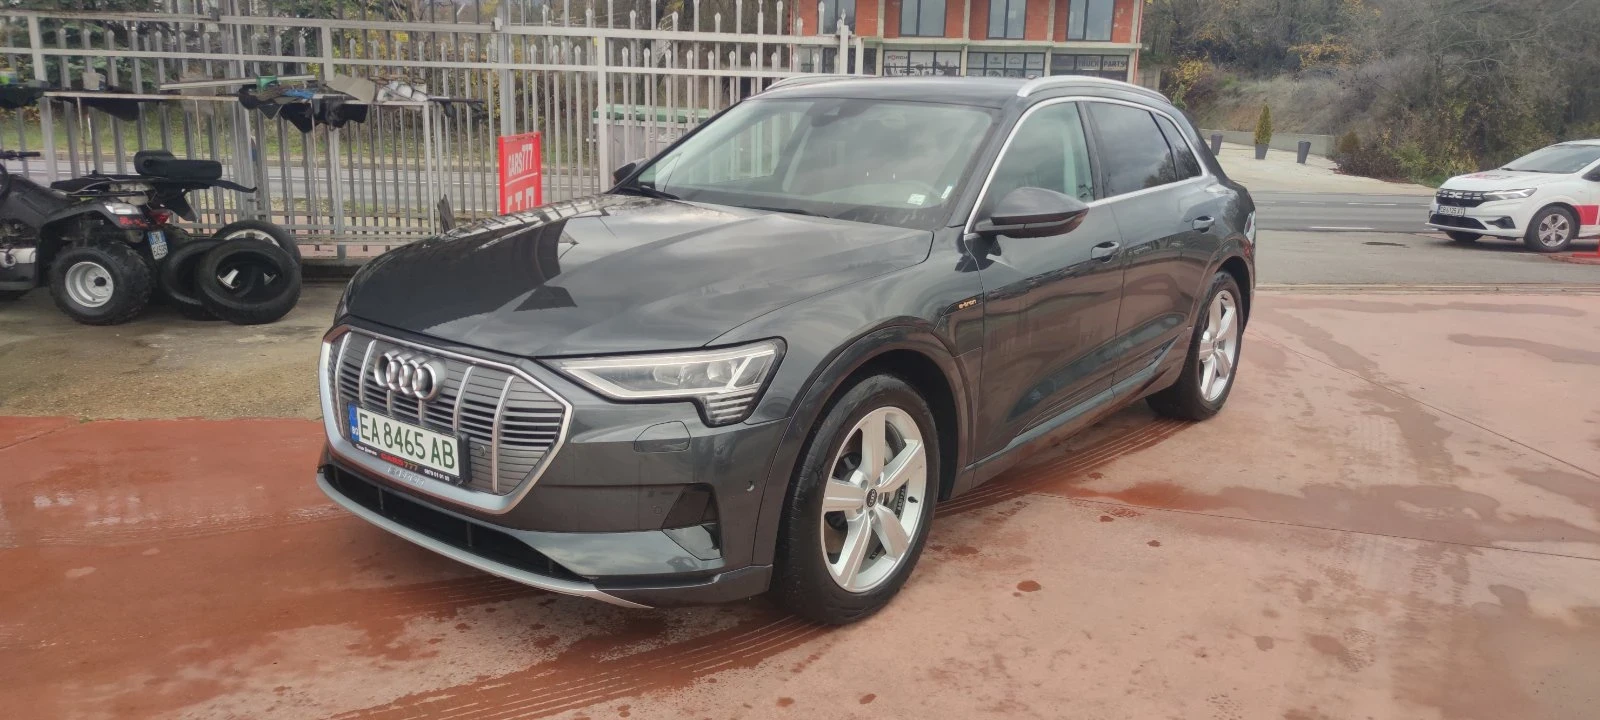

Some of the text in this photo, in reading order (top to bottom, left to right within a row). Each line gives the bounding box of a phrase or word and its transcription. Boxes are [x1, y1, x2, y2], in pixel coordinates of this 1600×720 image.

[359, 413, 380, 445] EA
[384, 421, 426, 460] 8465
[431, 437, 455, 469] AB
